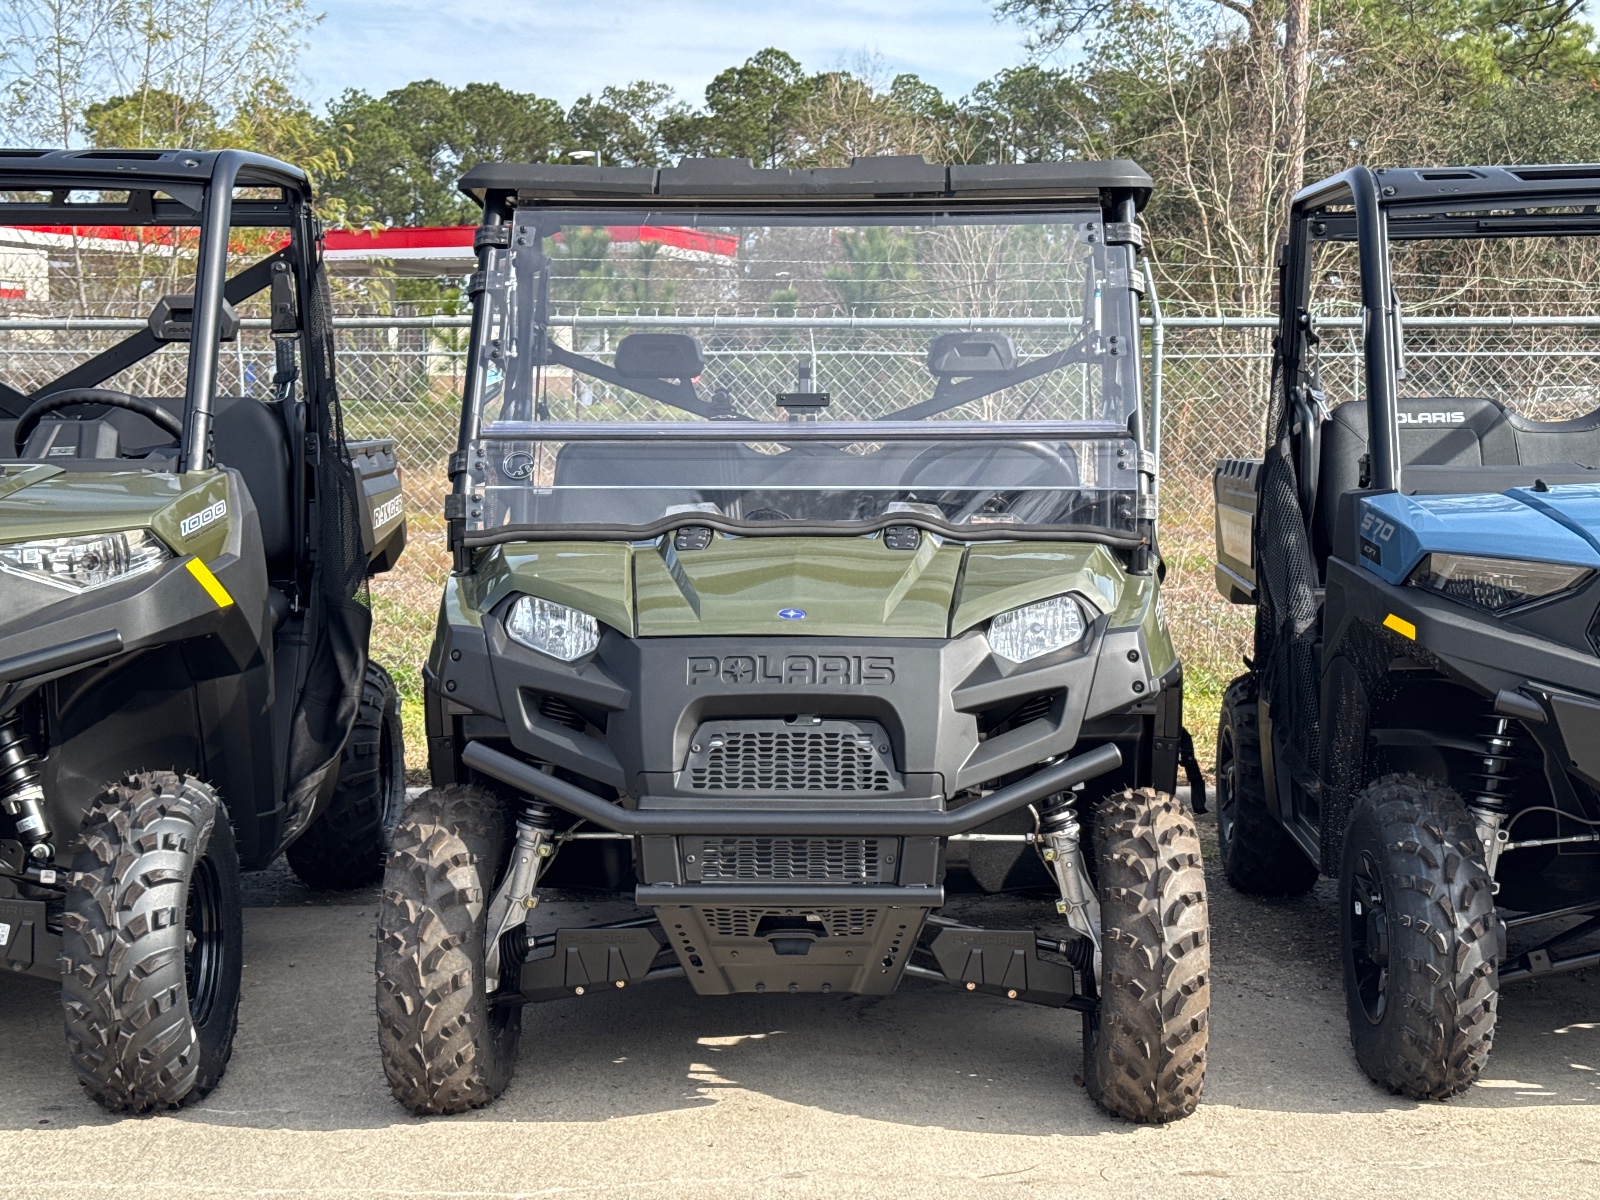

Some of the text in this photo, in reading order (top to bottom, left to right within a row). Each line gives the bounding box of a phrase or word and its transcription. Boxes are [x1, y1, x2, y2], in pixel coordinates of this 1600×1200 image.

[1397, 412, 1466, 424] OLARIS
[180, 499, 227, 537] 1000
[1360, 511, 1396, 542] 570
[1363, 545, 1377, 557] EFI
[686, 655, 896, 686] POLARIS
